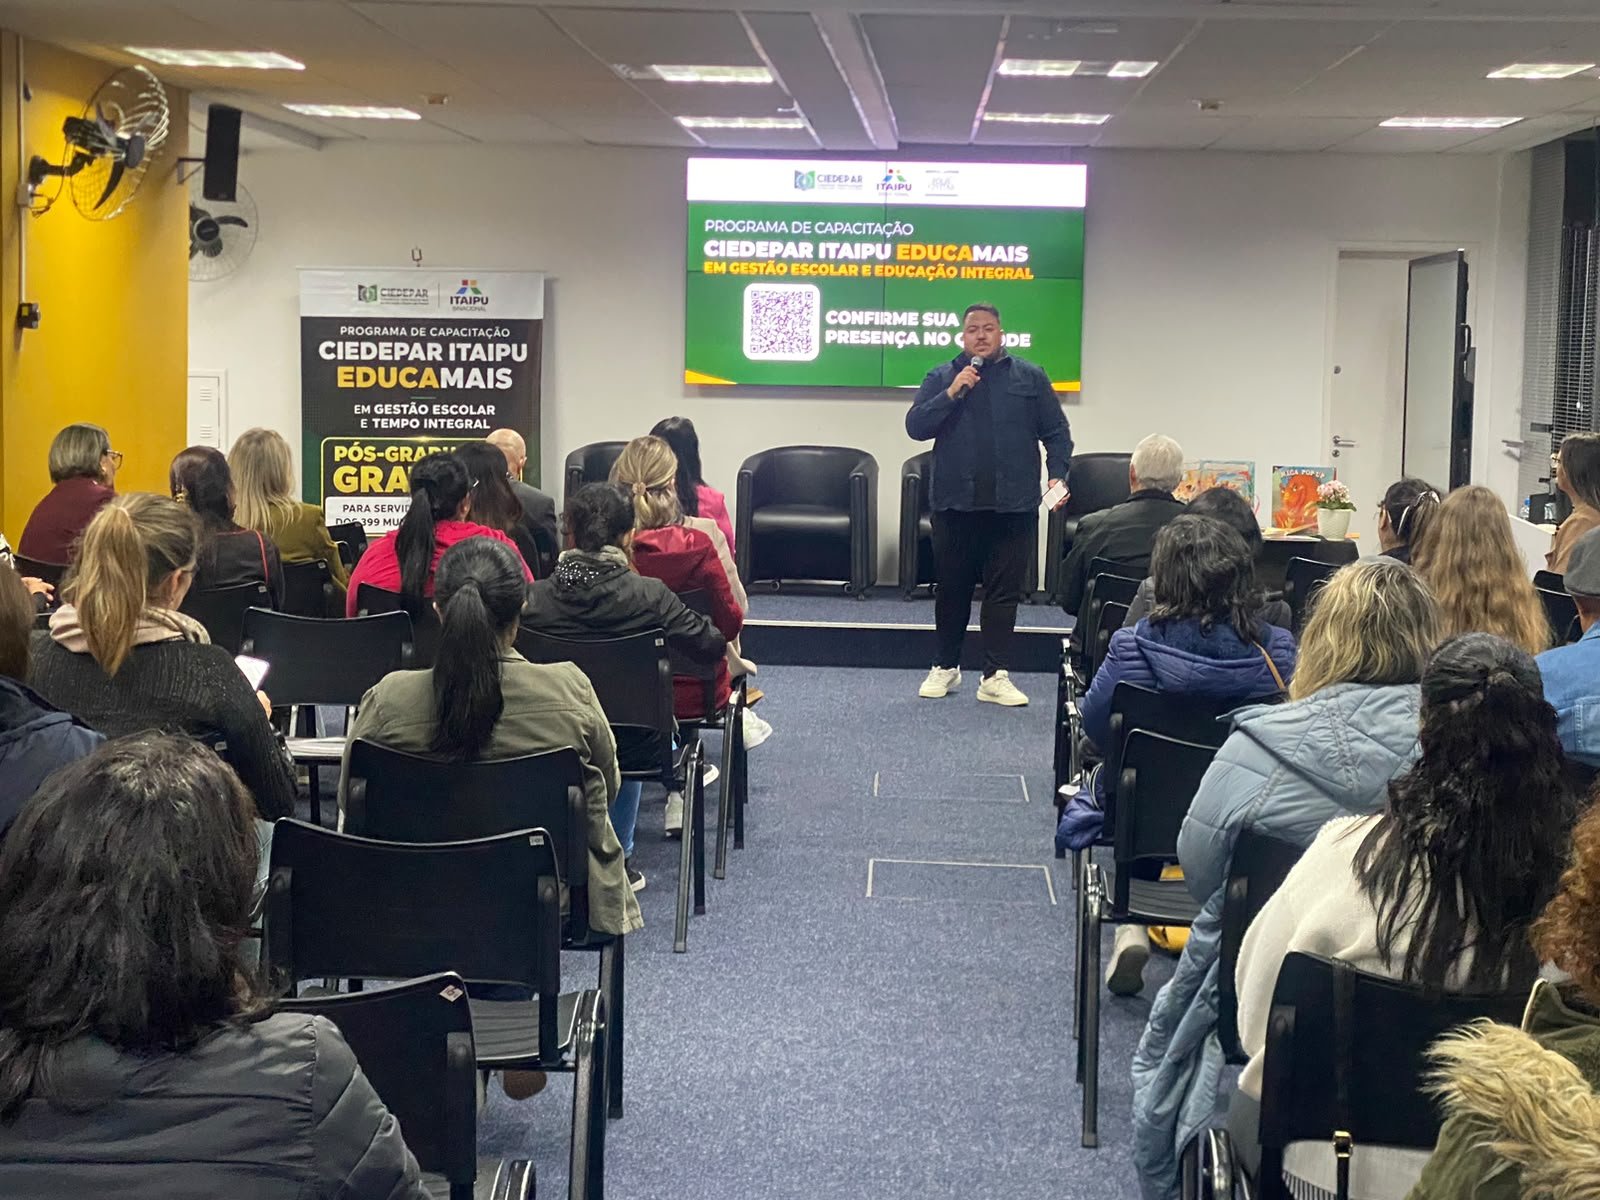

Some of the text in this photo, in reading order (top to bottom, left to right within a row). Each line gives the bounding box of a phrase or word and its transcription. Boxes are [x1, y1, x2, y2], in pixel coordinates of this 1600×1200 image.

[817, 174, 912, 191] CIEDEPAR ITAIPU
[704, 219, 914, 238] PROGRAMA DE CAPACITAÇÃO
[703, 240, 1029, 262] CIEDEPAR ITAIPU EDUCAMAIS
[703, 260, 1034, 281] EM GESTÃO ESCOLAR E EDUCAÇÃO INTEGRAL
[449, 296, 489, 305] ITAIPU
[825, 310, 960, 327] CONFIRME SUA
[340, 326, 510, 339] PROGRAMA DE CAPACITAÇÃO
[825, 330, 920, 349] PRESENÇA
[923, 331, 952, 346] NO
[318, 340, 528, 362] CIEDEPAR ITAIPU
[337, 366, 513, 389] EDUCAMAIS
[354, 402, 496, 416] EM GESTÃO ESCOLAR
[360, 418, 491, 429] E TEMPO INTEGRAL
[333, 465, 413, 493] GRA
[342, 504, 371, 513] PARA
[361, 517, 380, 527] 399
[383, 518, 403, 527] MU
